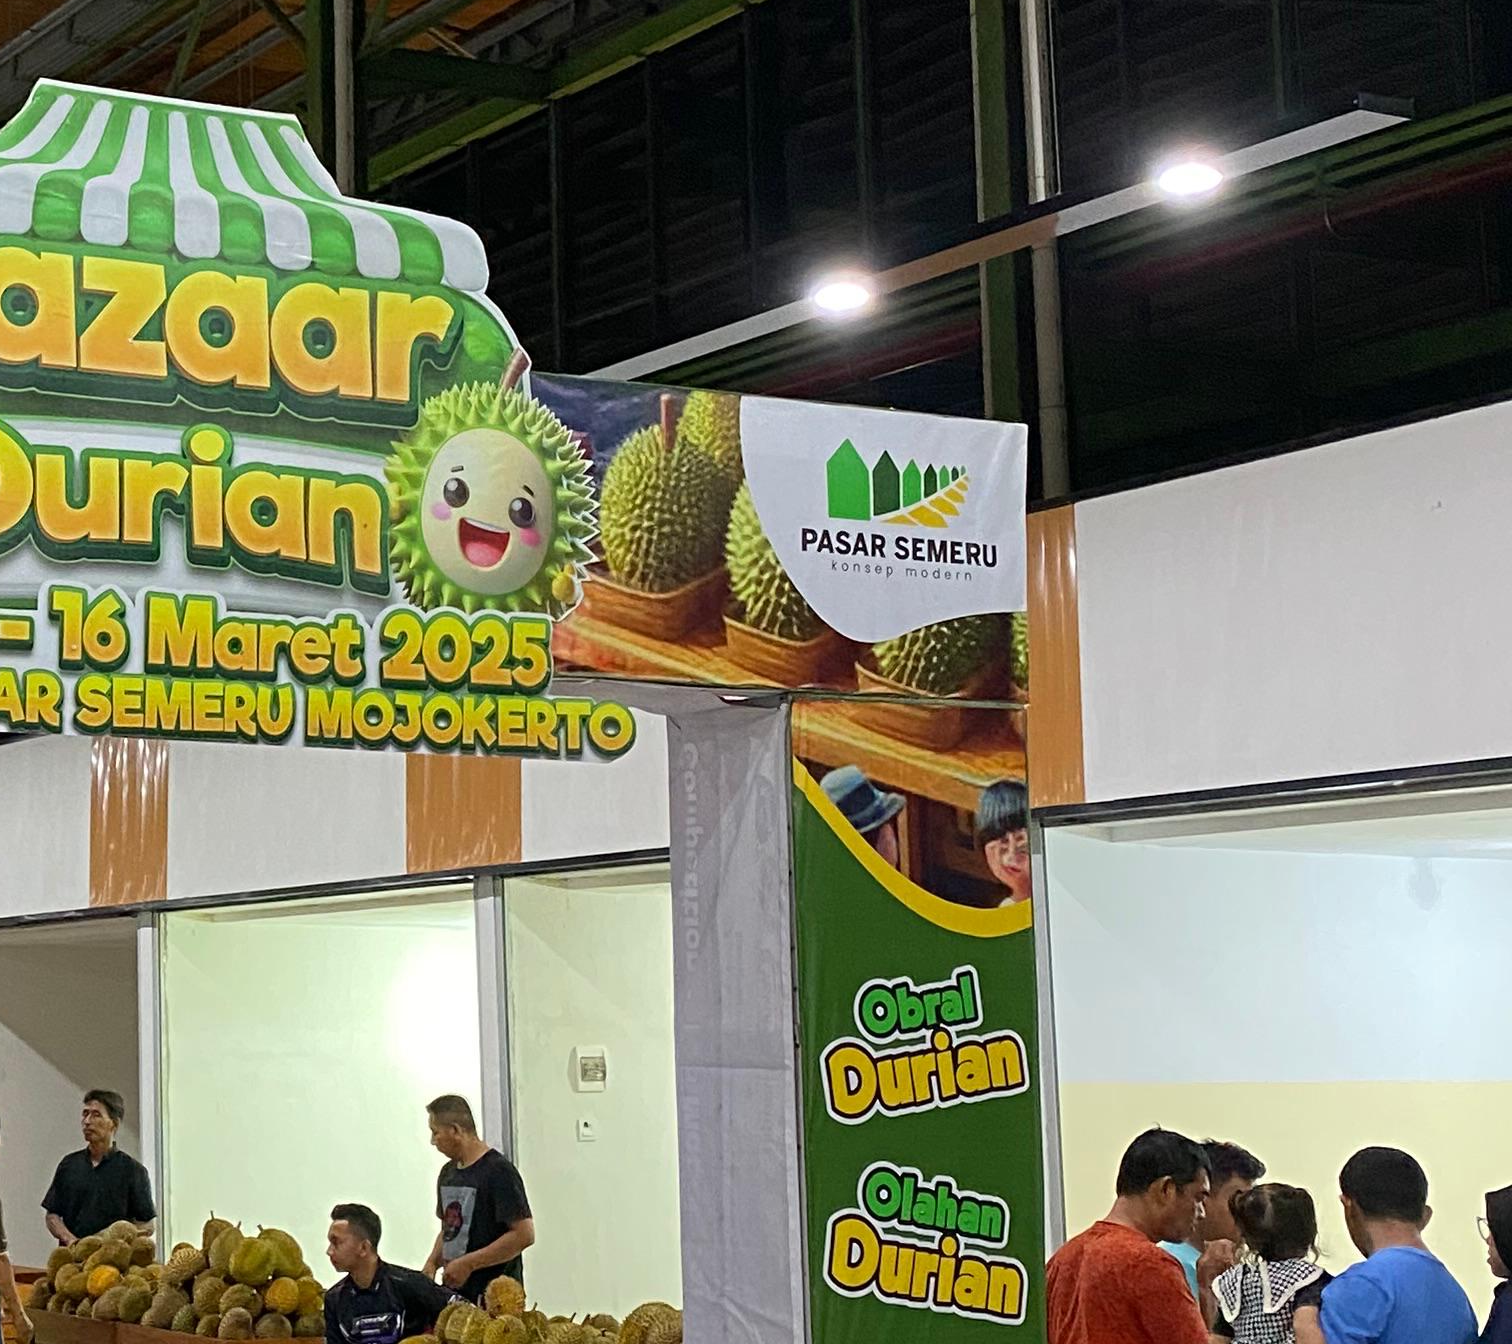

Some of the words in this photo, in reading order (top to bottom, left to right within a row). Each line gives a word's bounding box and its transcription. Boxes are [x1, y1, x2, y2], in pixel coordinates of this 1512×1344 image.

[800, 527, 886, 558] PASAR
[894, 536, 998, 568] SEMERU
[829, 559, 894, 579] konsep
[903, 565, 974, 583] modern
[47, 586, 126, 672] 16
[145, 596, 362, 682] Maret
[379, 609, 551, 690] 2025
[77, 675, 295, 740] SEMERU
[305, 689, 635, 755] MOJOKERTO
[858, 969, 979, 1037] Obral
[826, 1026, 1025, 1119] Durian
[862, 1165, 1006, 1241] Olahan
[828, 1213, 1024, 1319] Durian
